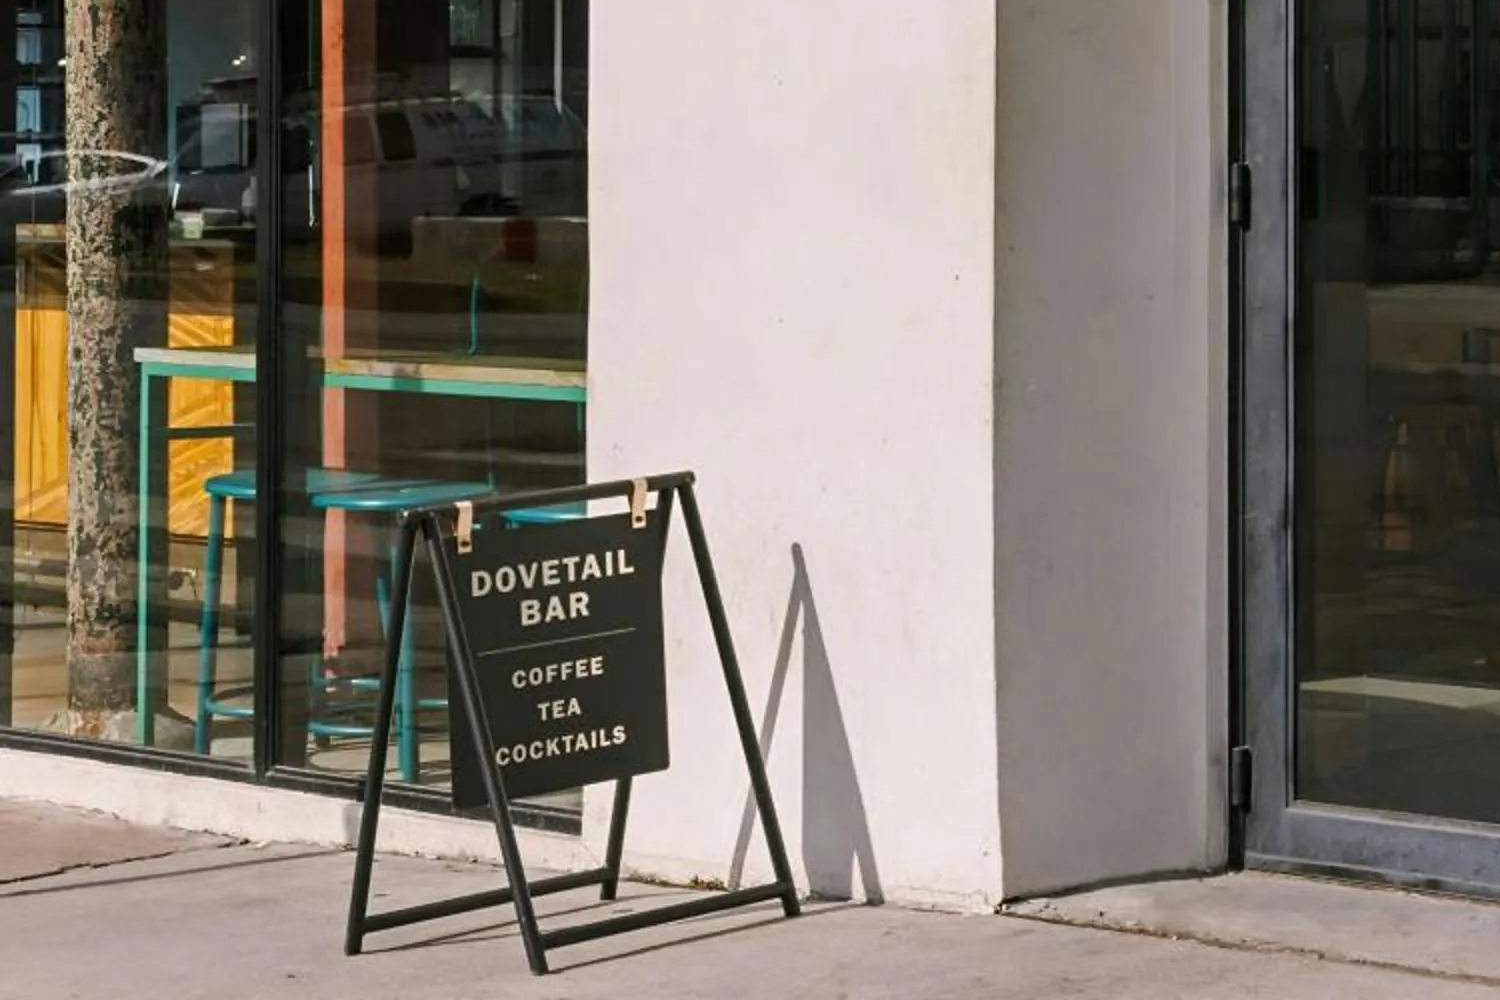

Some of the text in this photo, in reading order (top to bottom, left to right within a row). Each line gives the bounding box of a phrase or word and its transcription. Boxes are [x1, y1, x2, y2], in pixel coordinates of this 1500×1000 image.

[470, 549, 635, 598] DOVETAIL
[520, 591, 591, 627] BAR
[511, 655, 605, 689] COFFEE
[537, 697, 582, 722] TEA
[494, 724, 627, 766] COCKTAILS
